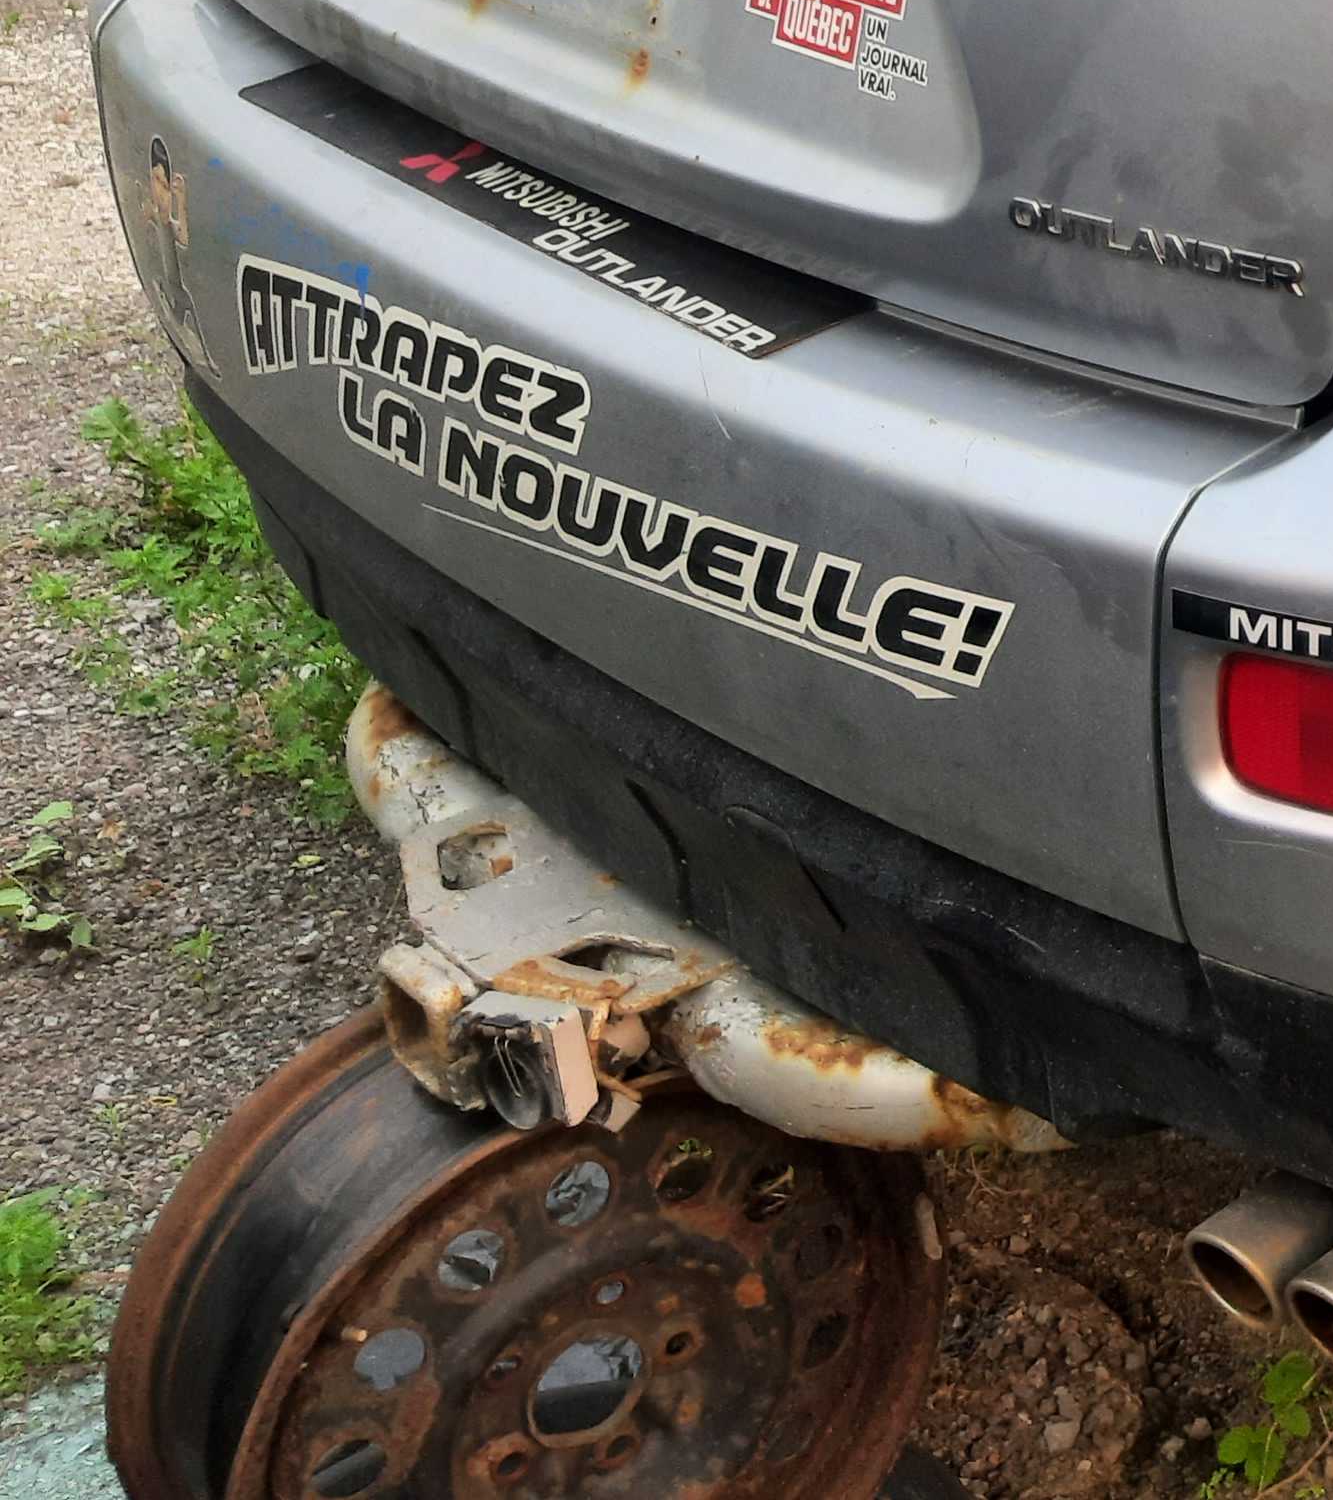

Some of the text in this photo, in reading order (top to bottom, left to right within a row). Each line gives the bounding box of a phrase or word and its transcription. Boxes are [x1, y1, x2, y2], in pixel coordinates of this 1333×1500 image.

[862, 46, 927, 83] JOURNAL
[867, 18, 887, 40] UN
[859, 71, 896, 99] VRAI.
[465, 161, 630, 239] MITSUBISHI
[533, 228, 777, 353] OUTLANDER
[1010, 196, 1304, 297] OUTLANDER
[241, 264, 588, 444] ATTRAPEZ
[343, 377, 1004, 677] LA NOUVELLE!
